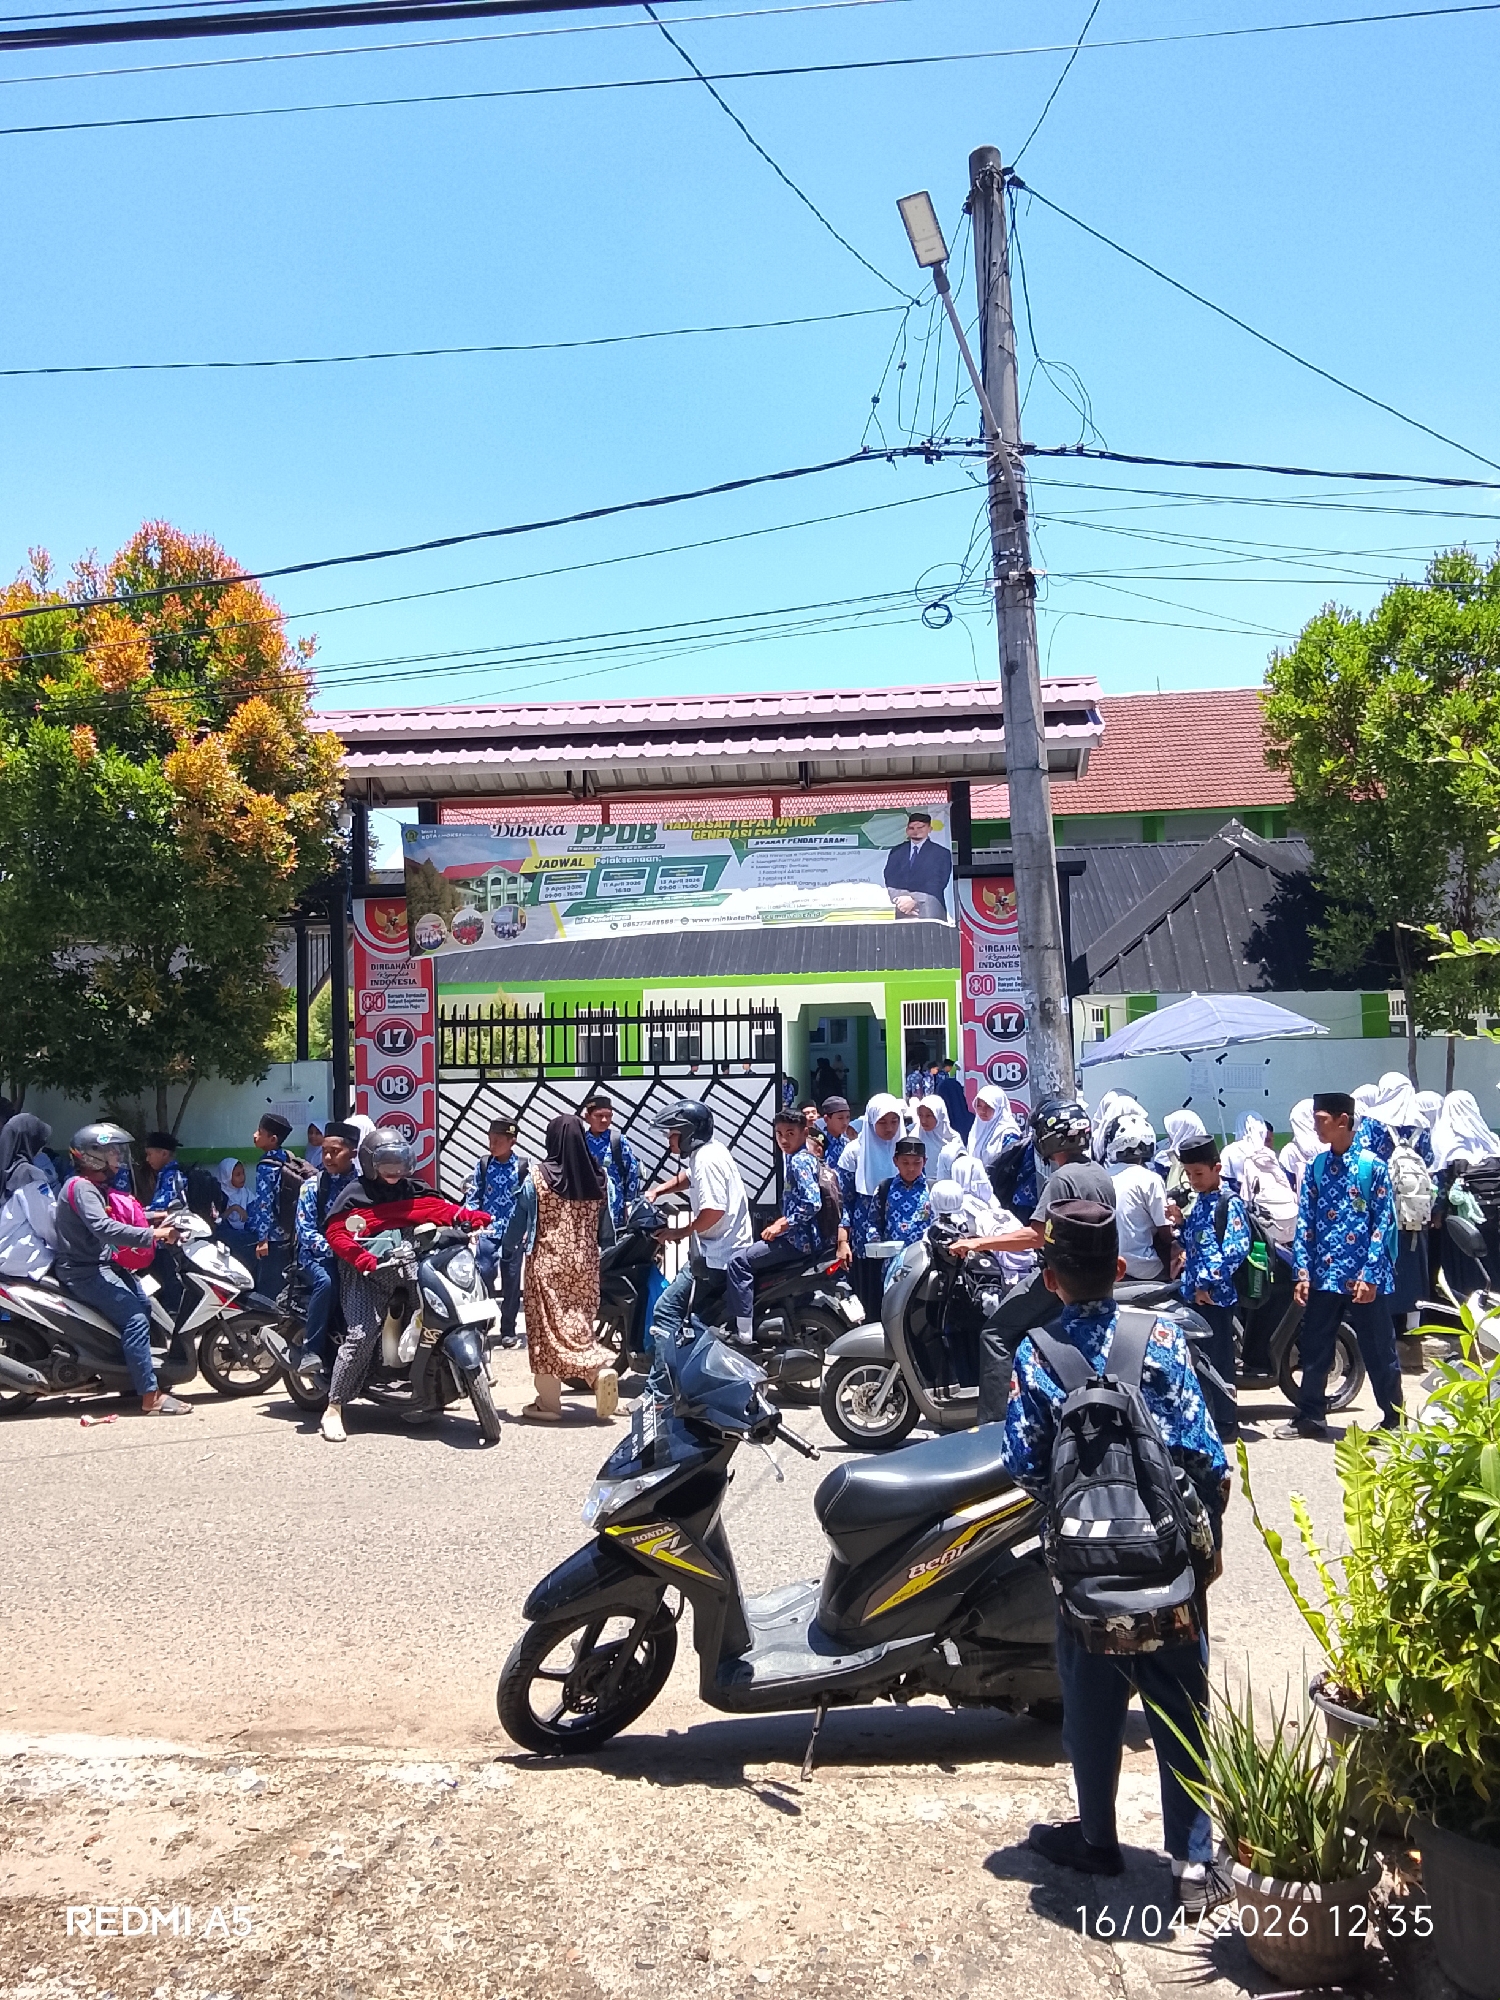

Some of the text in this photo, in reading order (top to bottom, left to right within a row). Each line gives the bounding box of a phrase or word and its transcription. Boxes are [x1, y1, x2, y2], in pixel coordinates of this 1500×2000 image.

[776, 817, 818, 827] UNTUK
[493, 823, 658, 844] Dibuka PPDB
[692, 829, 752, 840] GENERASI
[534, 858, 586, 869] JADWAL
[370, 962, 417, 971] DIRGAHAYU
[978, 960, 1020, 969] INDONES
[370, 978, 418, 987] INDONESIA
[968, 974, 996, 997] 80
[361, 991, 387, 1013] 80
[992, 1012, 1020, 1033] 17
[382, 1028, 408, 1048] 17
[992, 1062, 1022, 1082] 08
[381, 1075, 409, 1095] 08
[630, 1525, 674, 1545] HONDA
